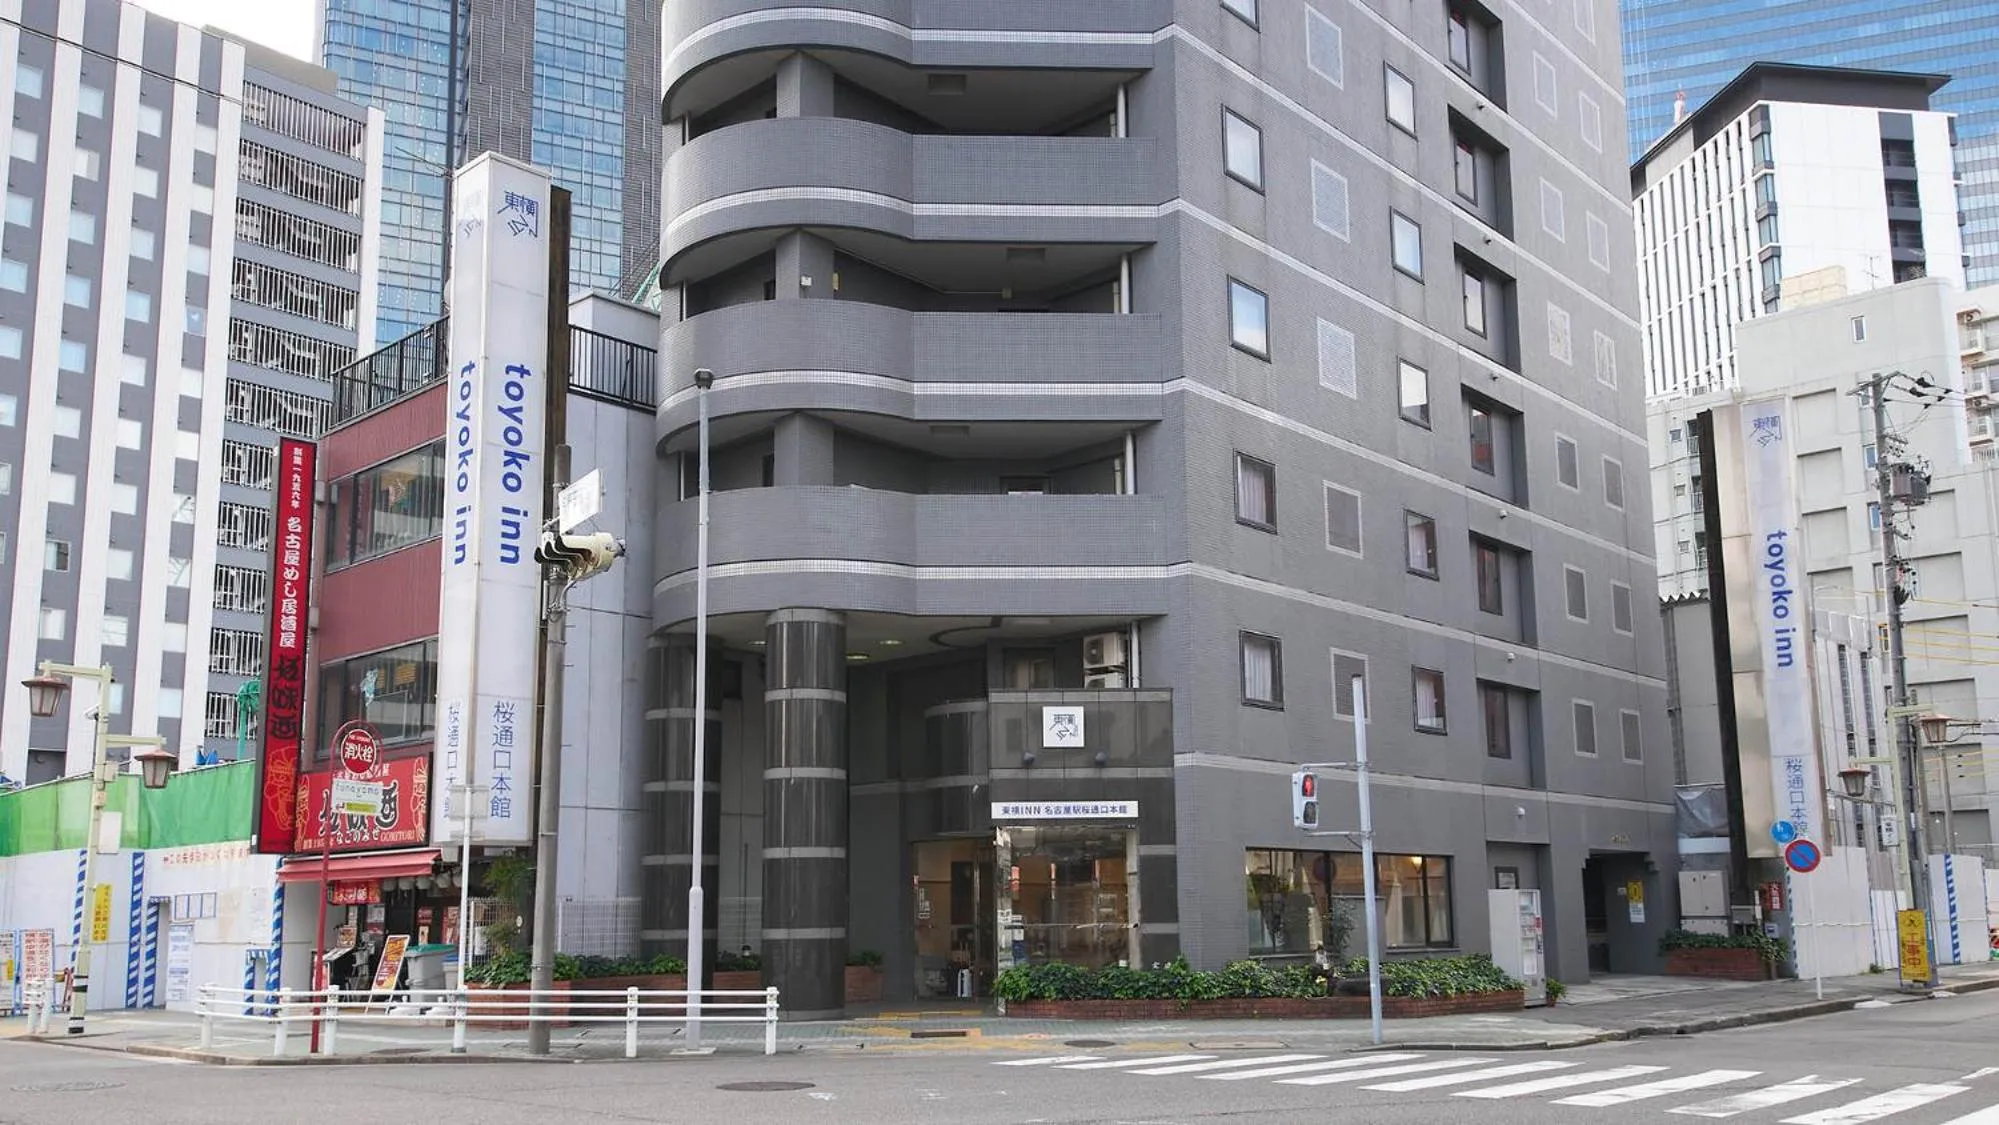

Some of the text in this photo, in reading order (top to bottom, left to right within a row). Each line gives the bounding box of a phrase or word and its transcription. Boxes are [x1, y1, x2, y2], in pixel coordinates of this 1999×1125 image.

[454, 360, 476, 565] toyoko inn
[498, 364, 532, 565] toyoko inn
[280, 517, 302, 648] 名古屋めし居酒屋
[1764, 530, 1796, 667] toyoko inn
[344, 742, 374, 762] 消火栓
[490, 701, 516, 818] 桜通口本館
[1906, 933, 1921, 967] 工事中
